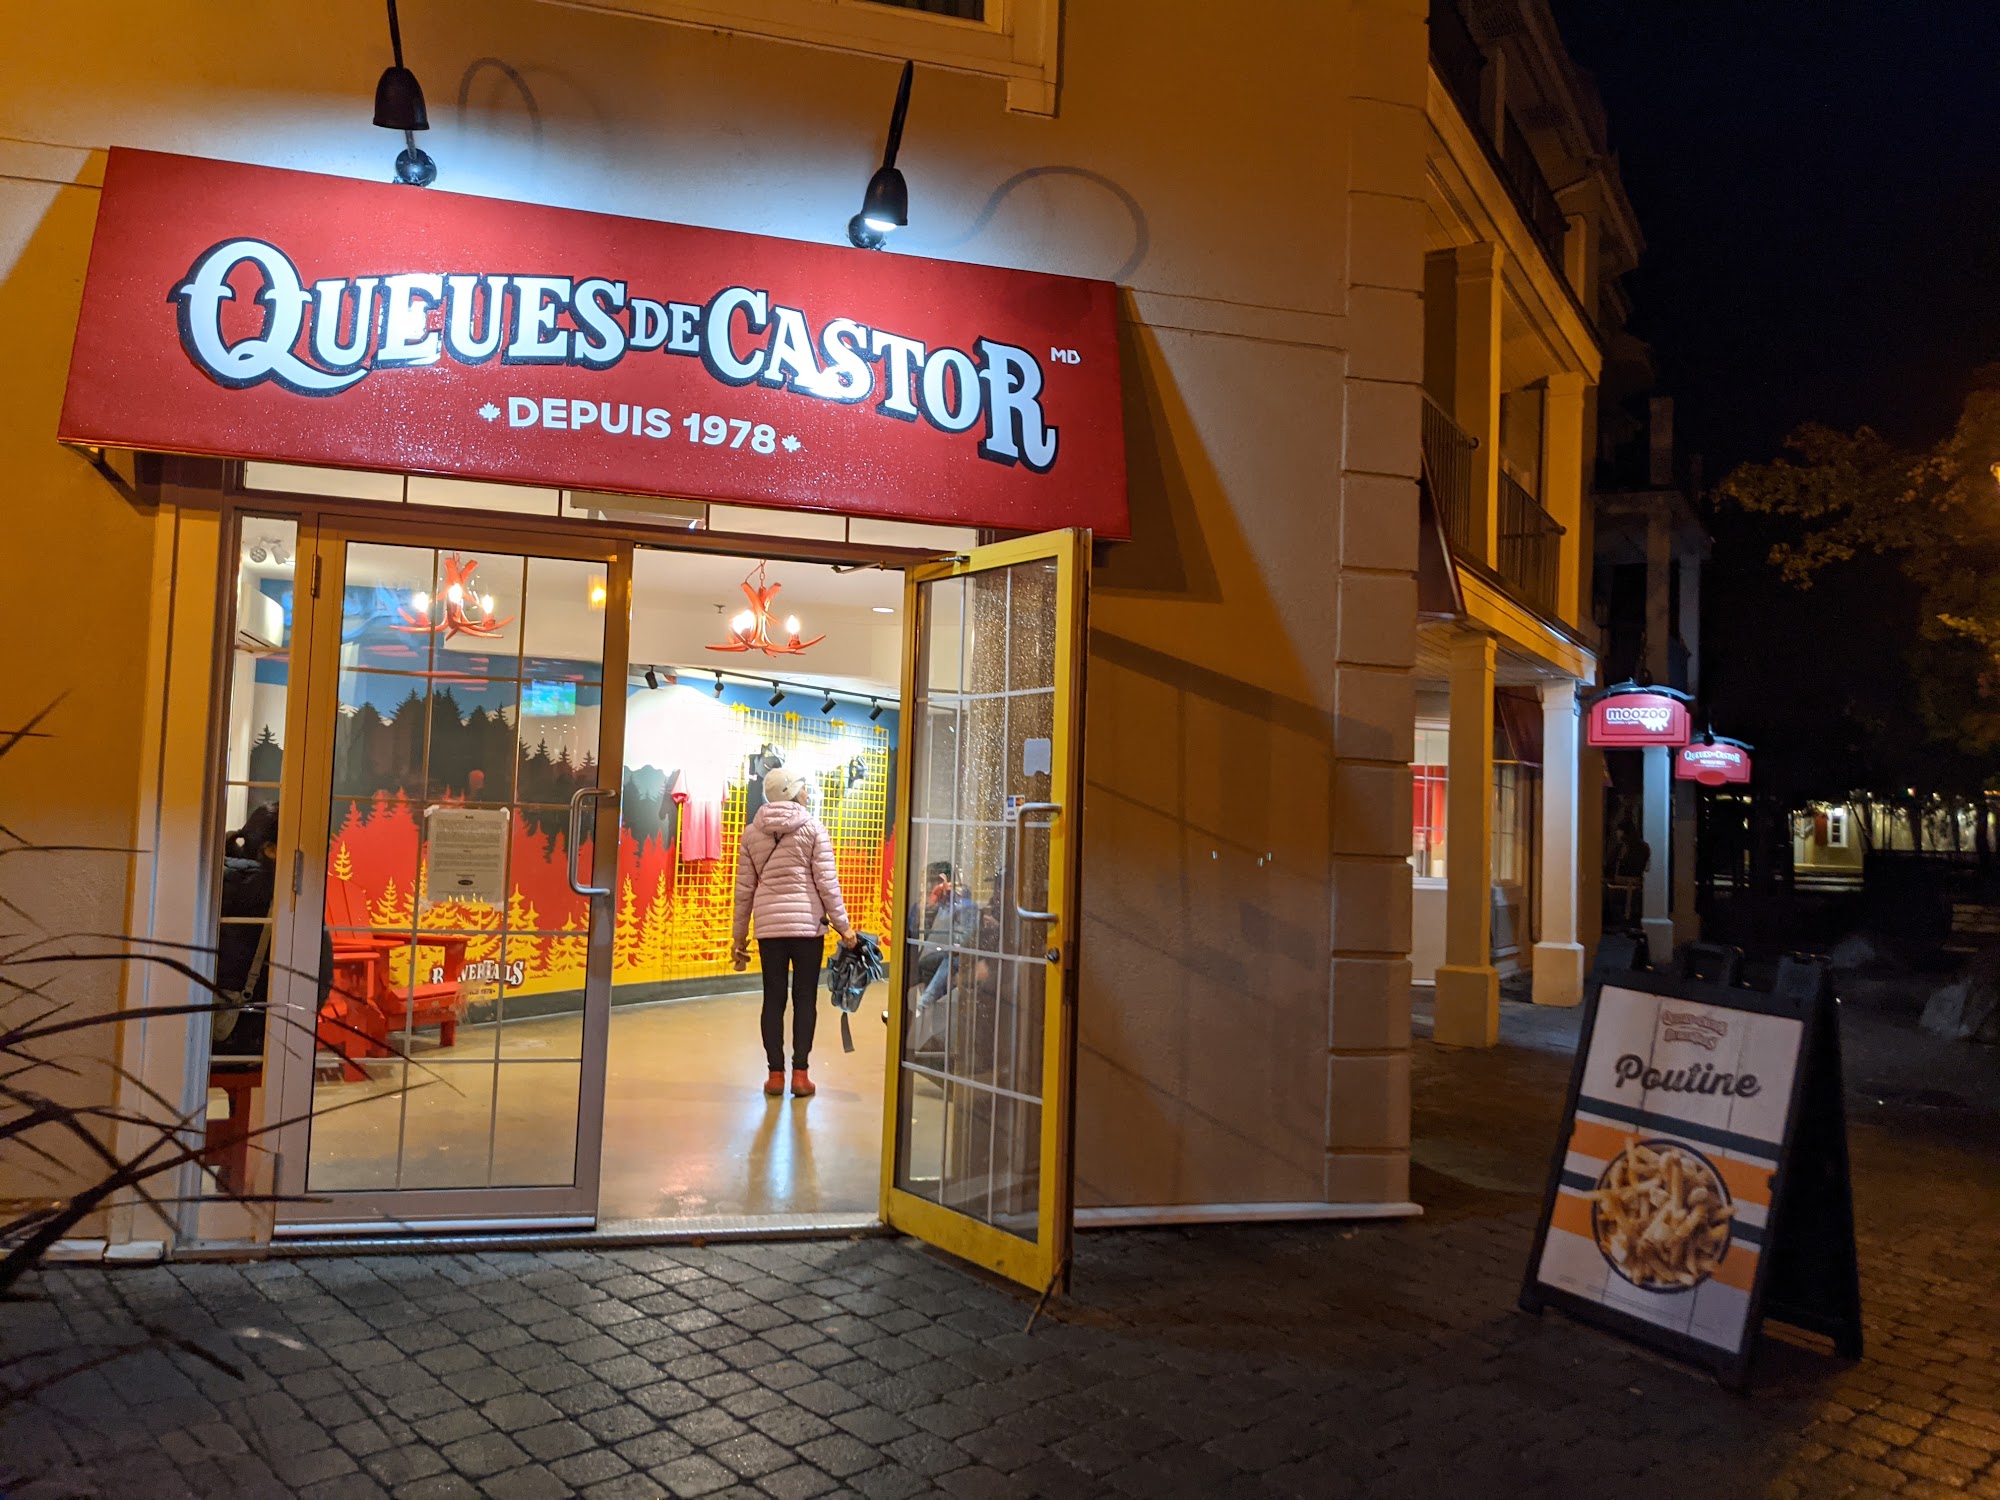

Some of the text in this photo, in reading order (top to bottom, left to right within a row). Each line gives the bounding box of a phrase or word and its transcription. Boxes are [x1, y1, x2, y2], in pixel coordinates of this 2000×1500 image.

[173, 239, 1081, 471] QUEUES DE CASTOR MD
[508, 396, 776, 454] DEPUIS 1978
[1607, 708, 1669, 719] moozoo
[1615, 1054, 1761, 1098] Poutine
